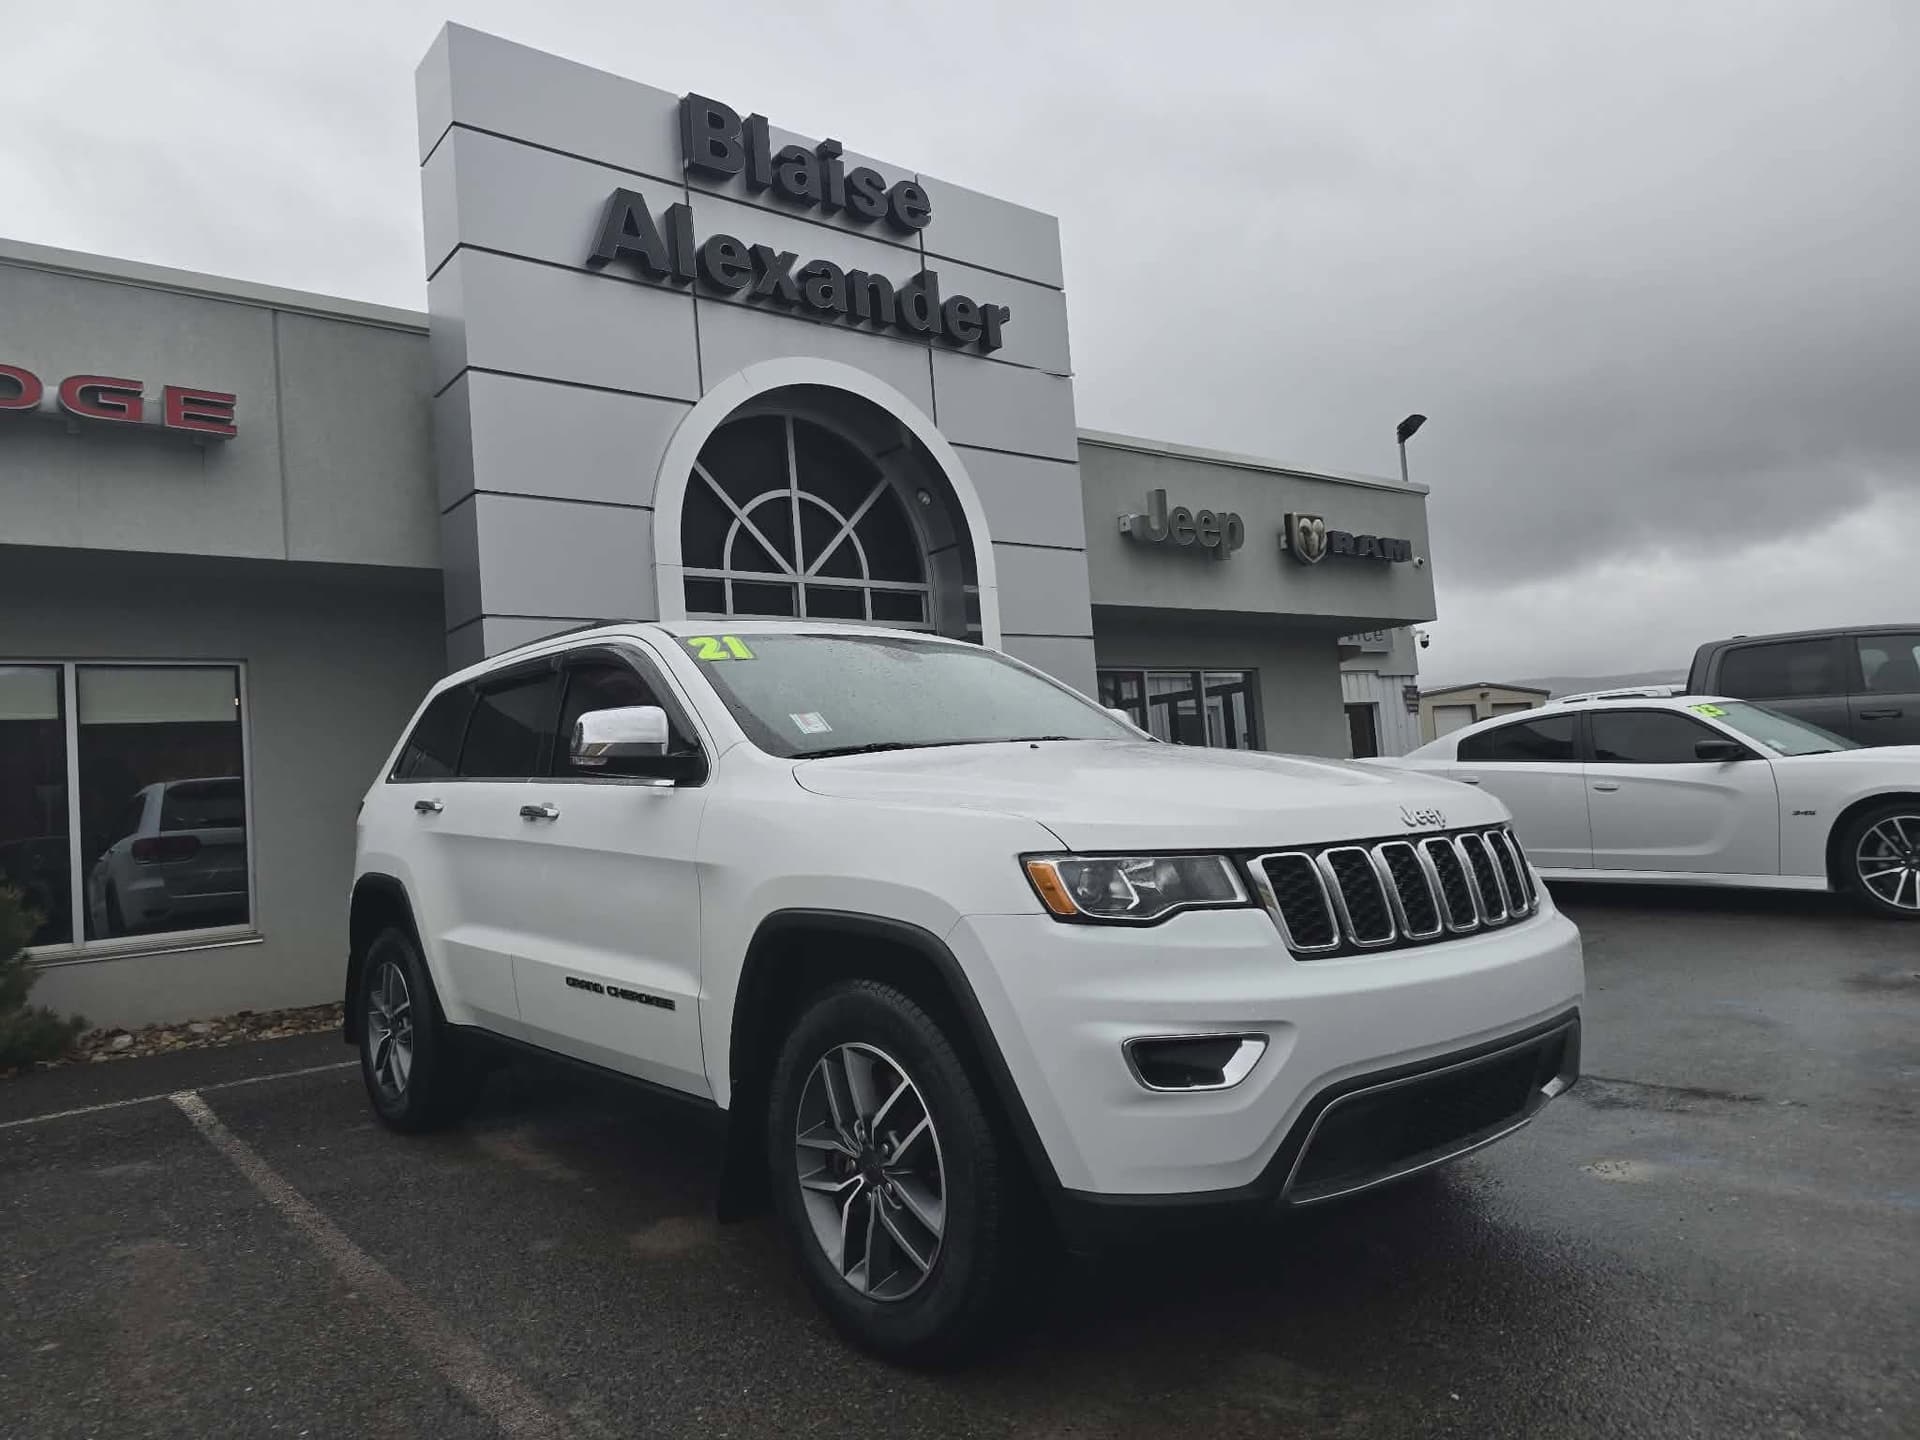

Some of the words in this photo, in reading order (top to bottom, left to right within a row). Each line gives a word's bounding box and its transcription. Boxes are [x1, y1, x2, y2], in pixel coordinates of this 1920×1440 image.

[680, 92, 932, 233] Blaise
[586, 187, 1011, 356] Alexander
[1130, 488, 1245, 560] Jeep
[1327, 530, 1412, 562] RAM
[687, 635, 756, 661] 21
[1399, 805, 1447, 830] Jeep
[565, 976, 604, 995] GRAND
[606, 985, 676, 1012] CHEROKEE
